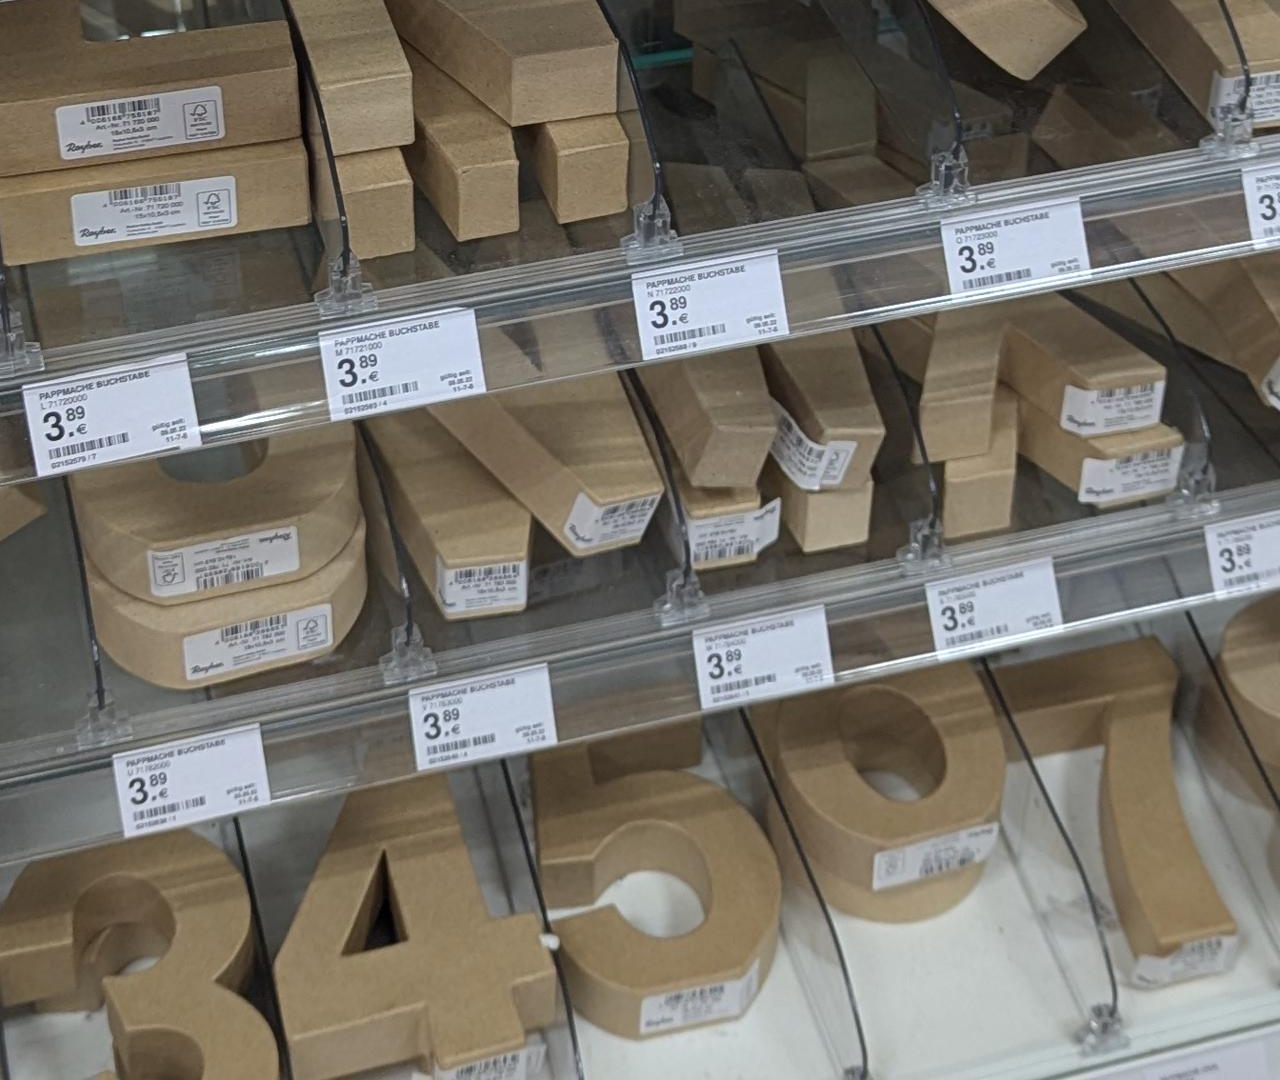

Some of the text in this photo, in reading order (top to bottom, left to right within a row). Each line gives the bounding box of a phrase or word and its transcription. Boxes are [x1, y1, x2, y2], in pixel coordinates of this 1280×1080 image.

[954, 211, 1050, 235] PAPPMACHE BUCHSTABE
[646, 264, 746, 290] PAPPMACHE BUCHSTABE
[334, 319, 440, 348] PAPPMACHE BUCHSTABE
[39, 370, 151, 401] PAPPMACHE BUCHSTABE
